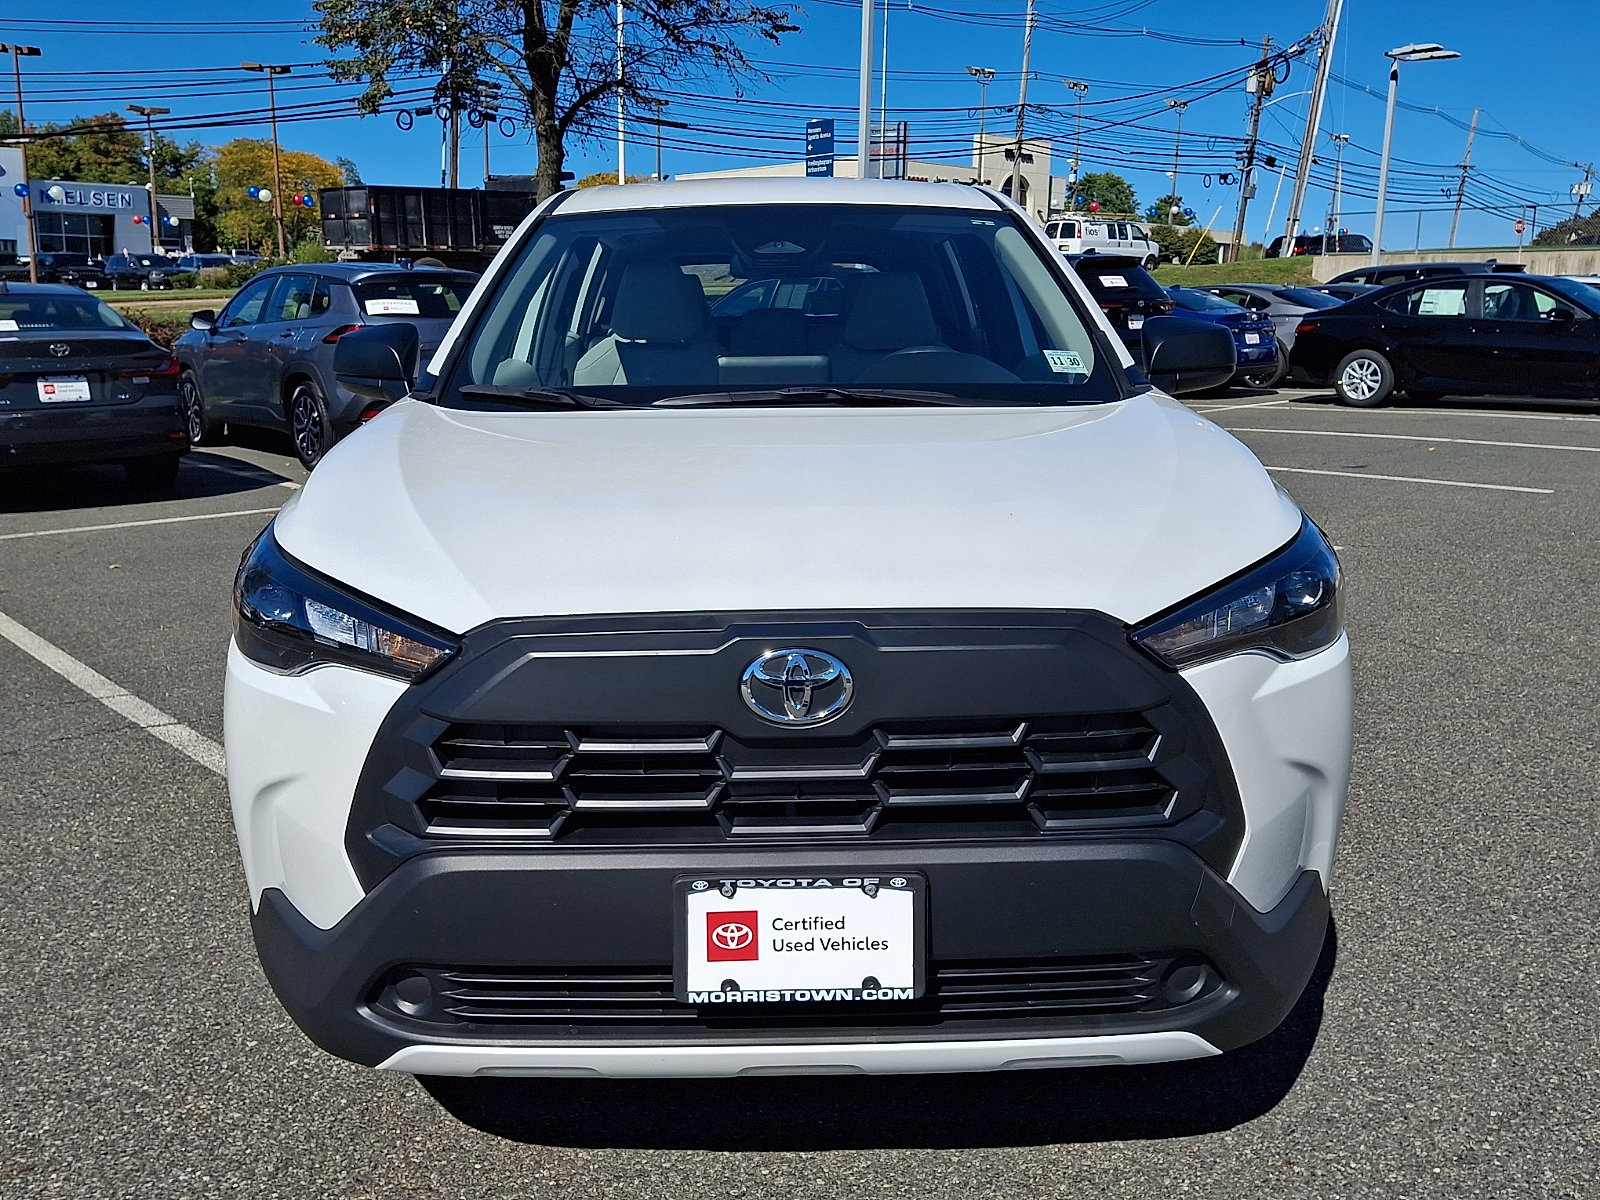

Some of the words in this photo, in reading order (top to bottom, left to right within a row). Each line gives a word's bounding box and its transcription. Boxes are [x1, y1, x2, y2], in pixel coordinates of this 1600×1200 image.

[41, 189, 132, 208] NELSEN
[1085, 226, 1099, 236] fios
[1050, 356, 1065, 366] 11
[1066, 357, 1081, 367] 30
[719, 878, 836, 888] TOYOTA
[842, 878, 880, 888] OF
[771, 915, 846, 931] Certified
[772, 937, 815, 952] Used
[819, 936, 889, 951] Vehicles
[688, 988, 914, 1004] MORRISTOWN.COM
